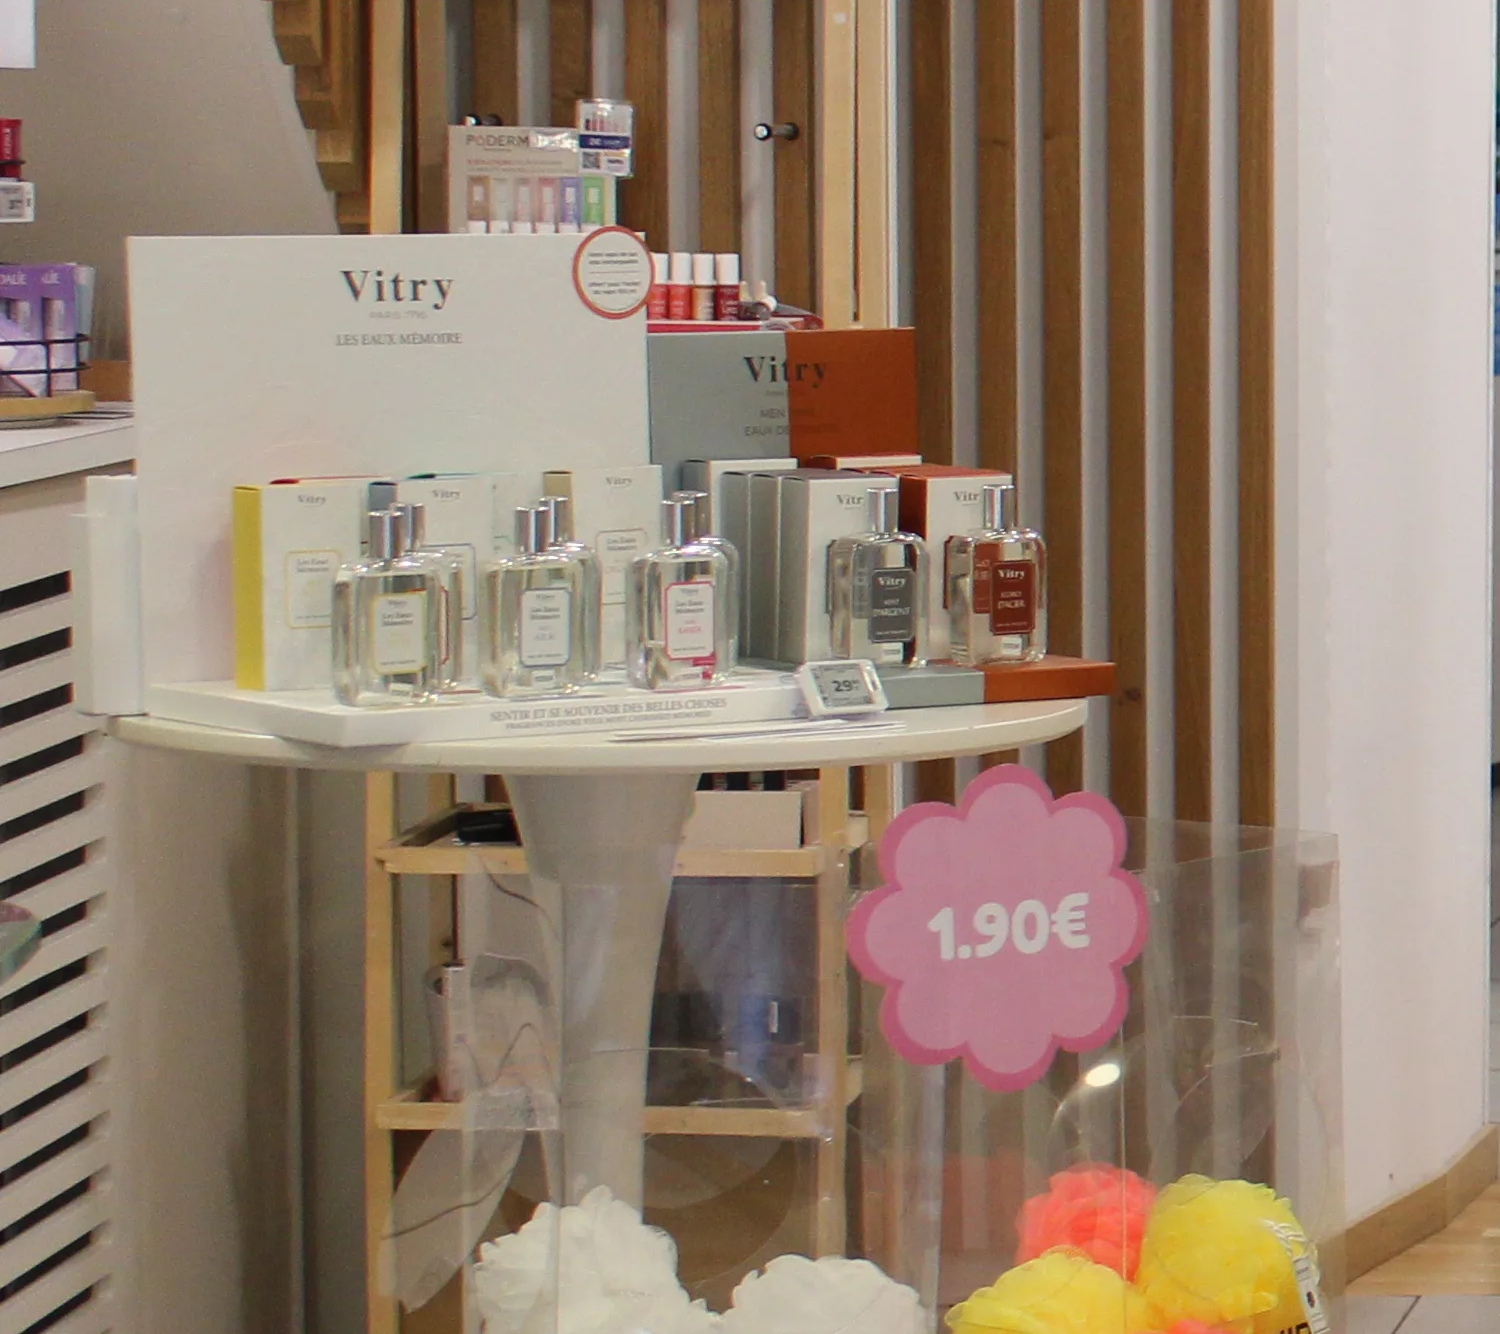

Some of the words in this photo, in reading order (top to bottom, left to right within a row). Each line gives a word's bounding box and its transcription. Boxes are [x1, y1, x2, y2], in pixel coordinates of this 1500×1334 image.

[340, 270, 455, 309] Vitry
[336, 334, 358, 347] LES
[361, 334, 395, 346] EAUX
[744, 355, 828, 387] Vitry
[490, 708, 529, 722] SENTIR
[533, 707, 547, 720] ET
[564, 703, 619, 718] SOUVENIR
[622, 701, 643, 714] DES
[645, 699, 683, 712] BELLES
[685, 697, 727, 710] CHOSES
[927, 892, 1090, 961] 1.90€
